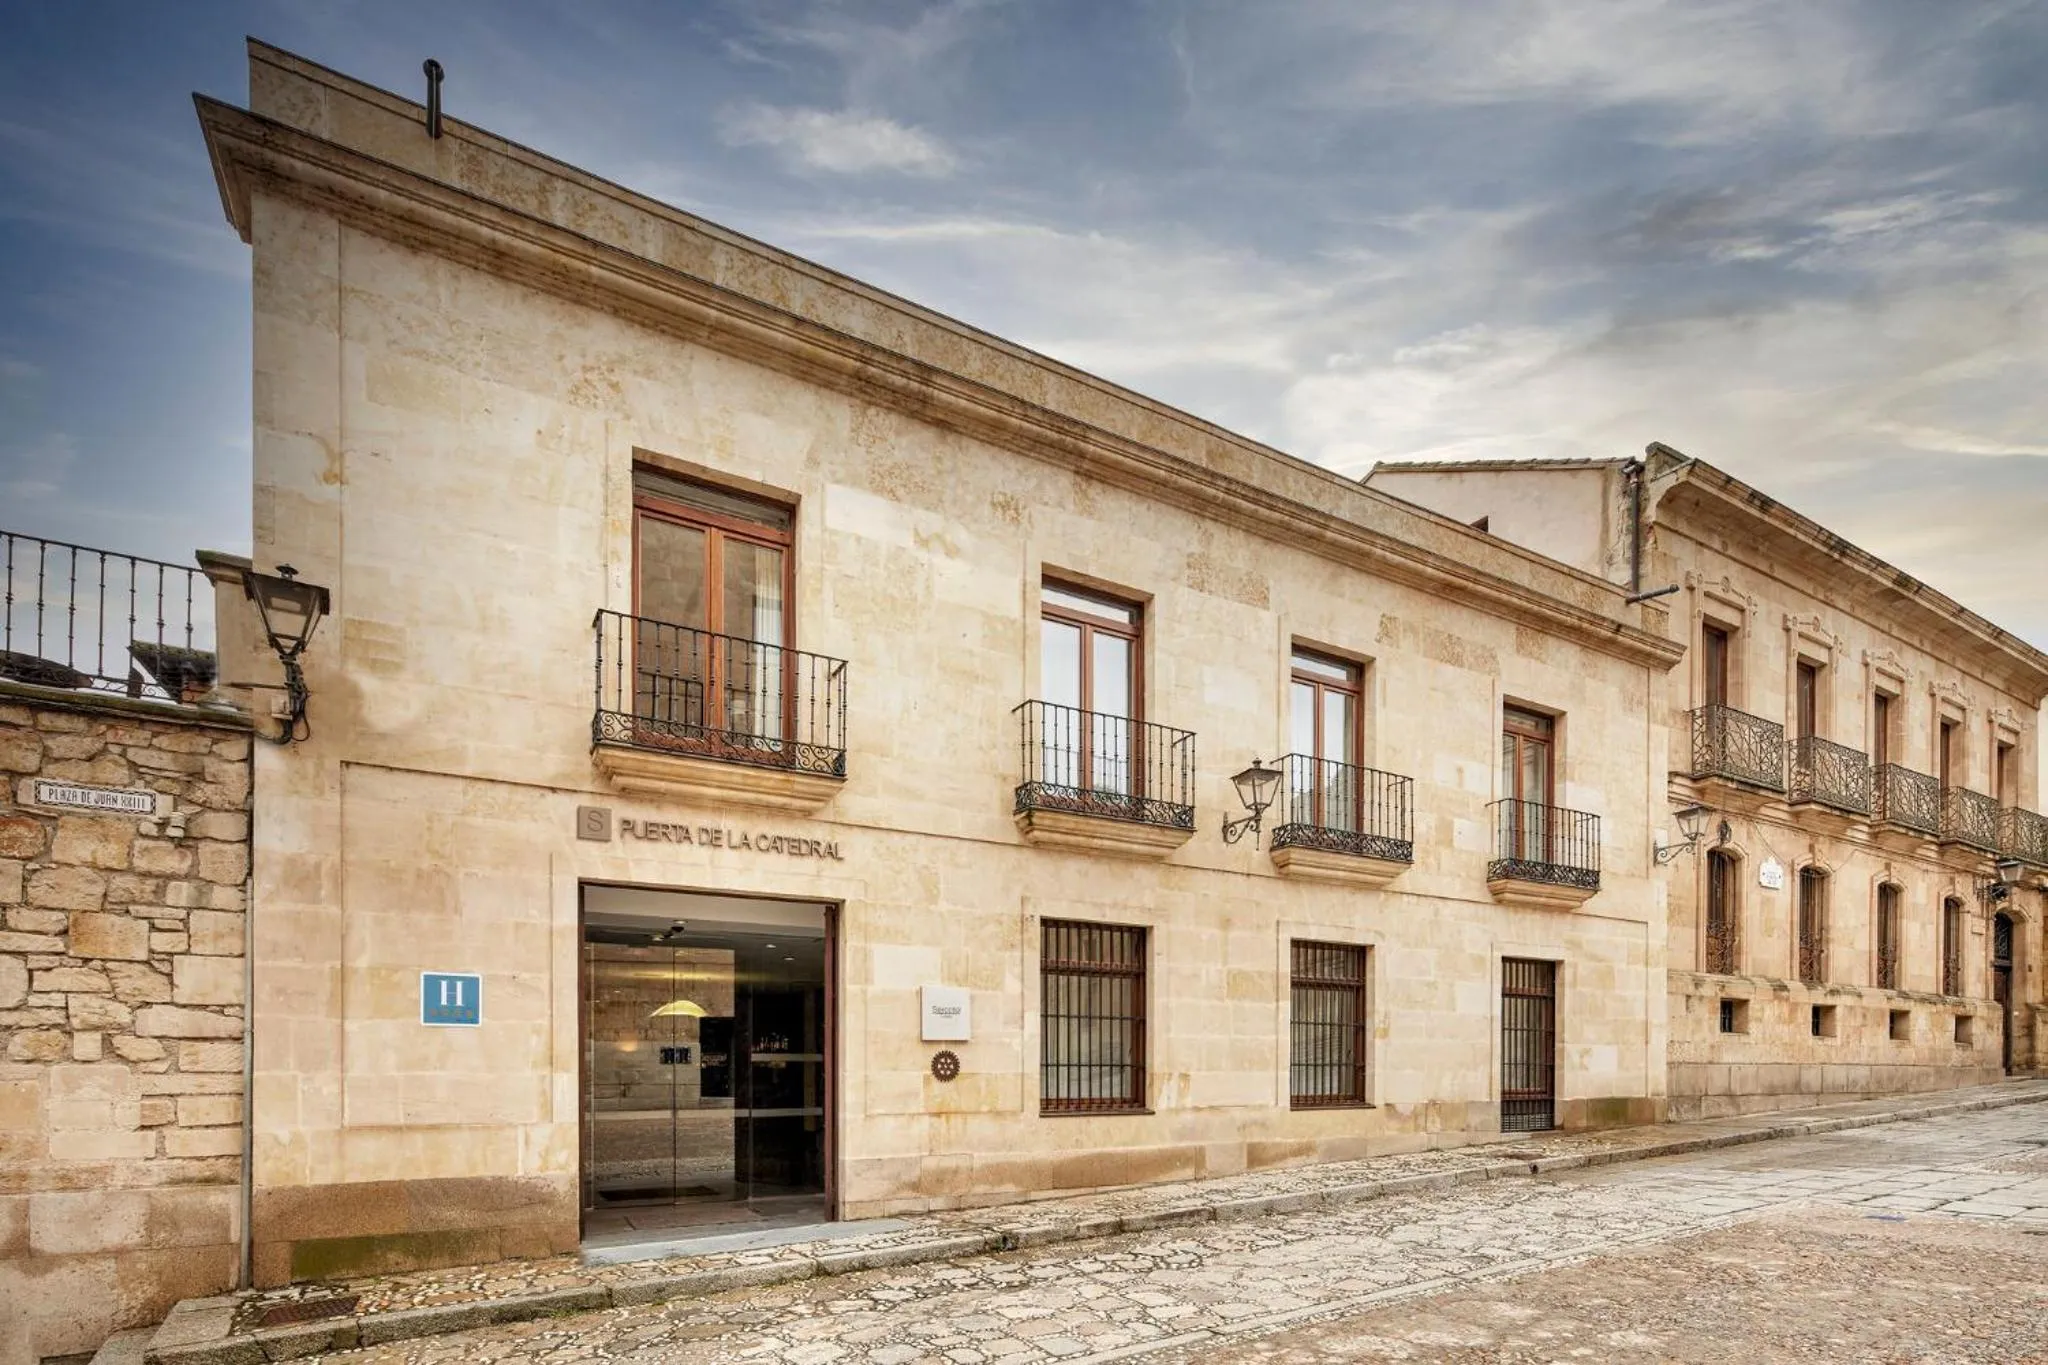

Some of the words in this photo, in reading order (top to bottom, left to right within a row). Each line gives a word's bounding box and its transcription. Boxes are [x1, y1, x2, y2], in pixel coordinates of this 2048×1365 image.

[48, 786, 77, 802] PLAZA
[81, 790, 91, 804] DE
[94, 793, 118, 807] JUAN
[121, 795, 145, 809] XXIII
[587, 809, 604, 832] S
[620, 819, 693, 845] PUERTA
[698, 827, 722, 847] DE
[727, 829, 752, 851] LA
[756, 833, 844, 861] CATEDRAL
[440, 979, 465, 1006] H
